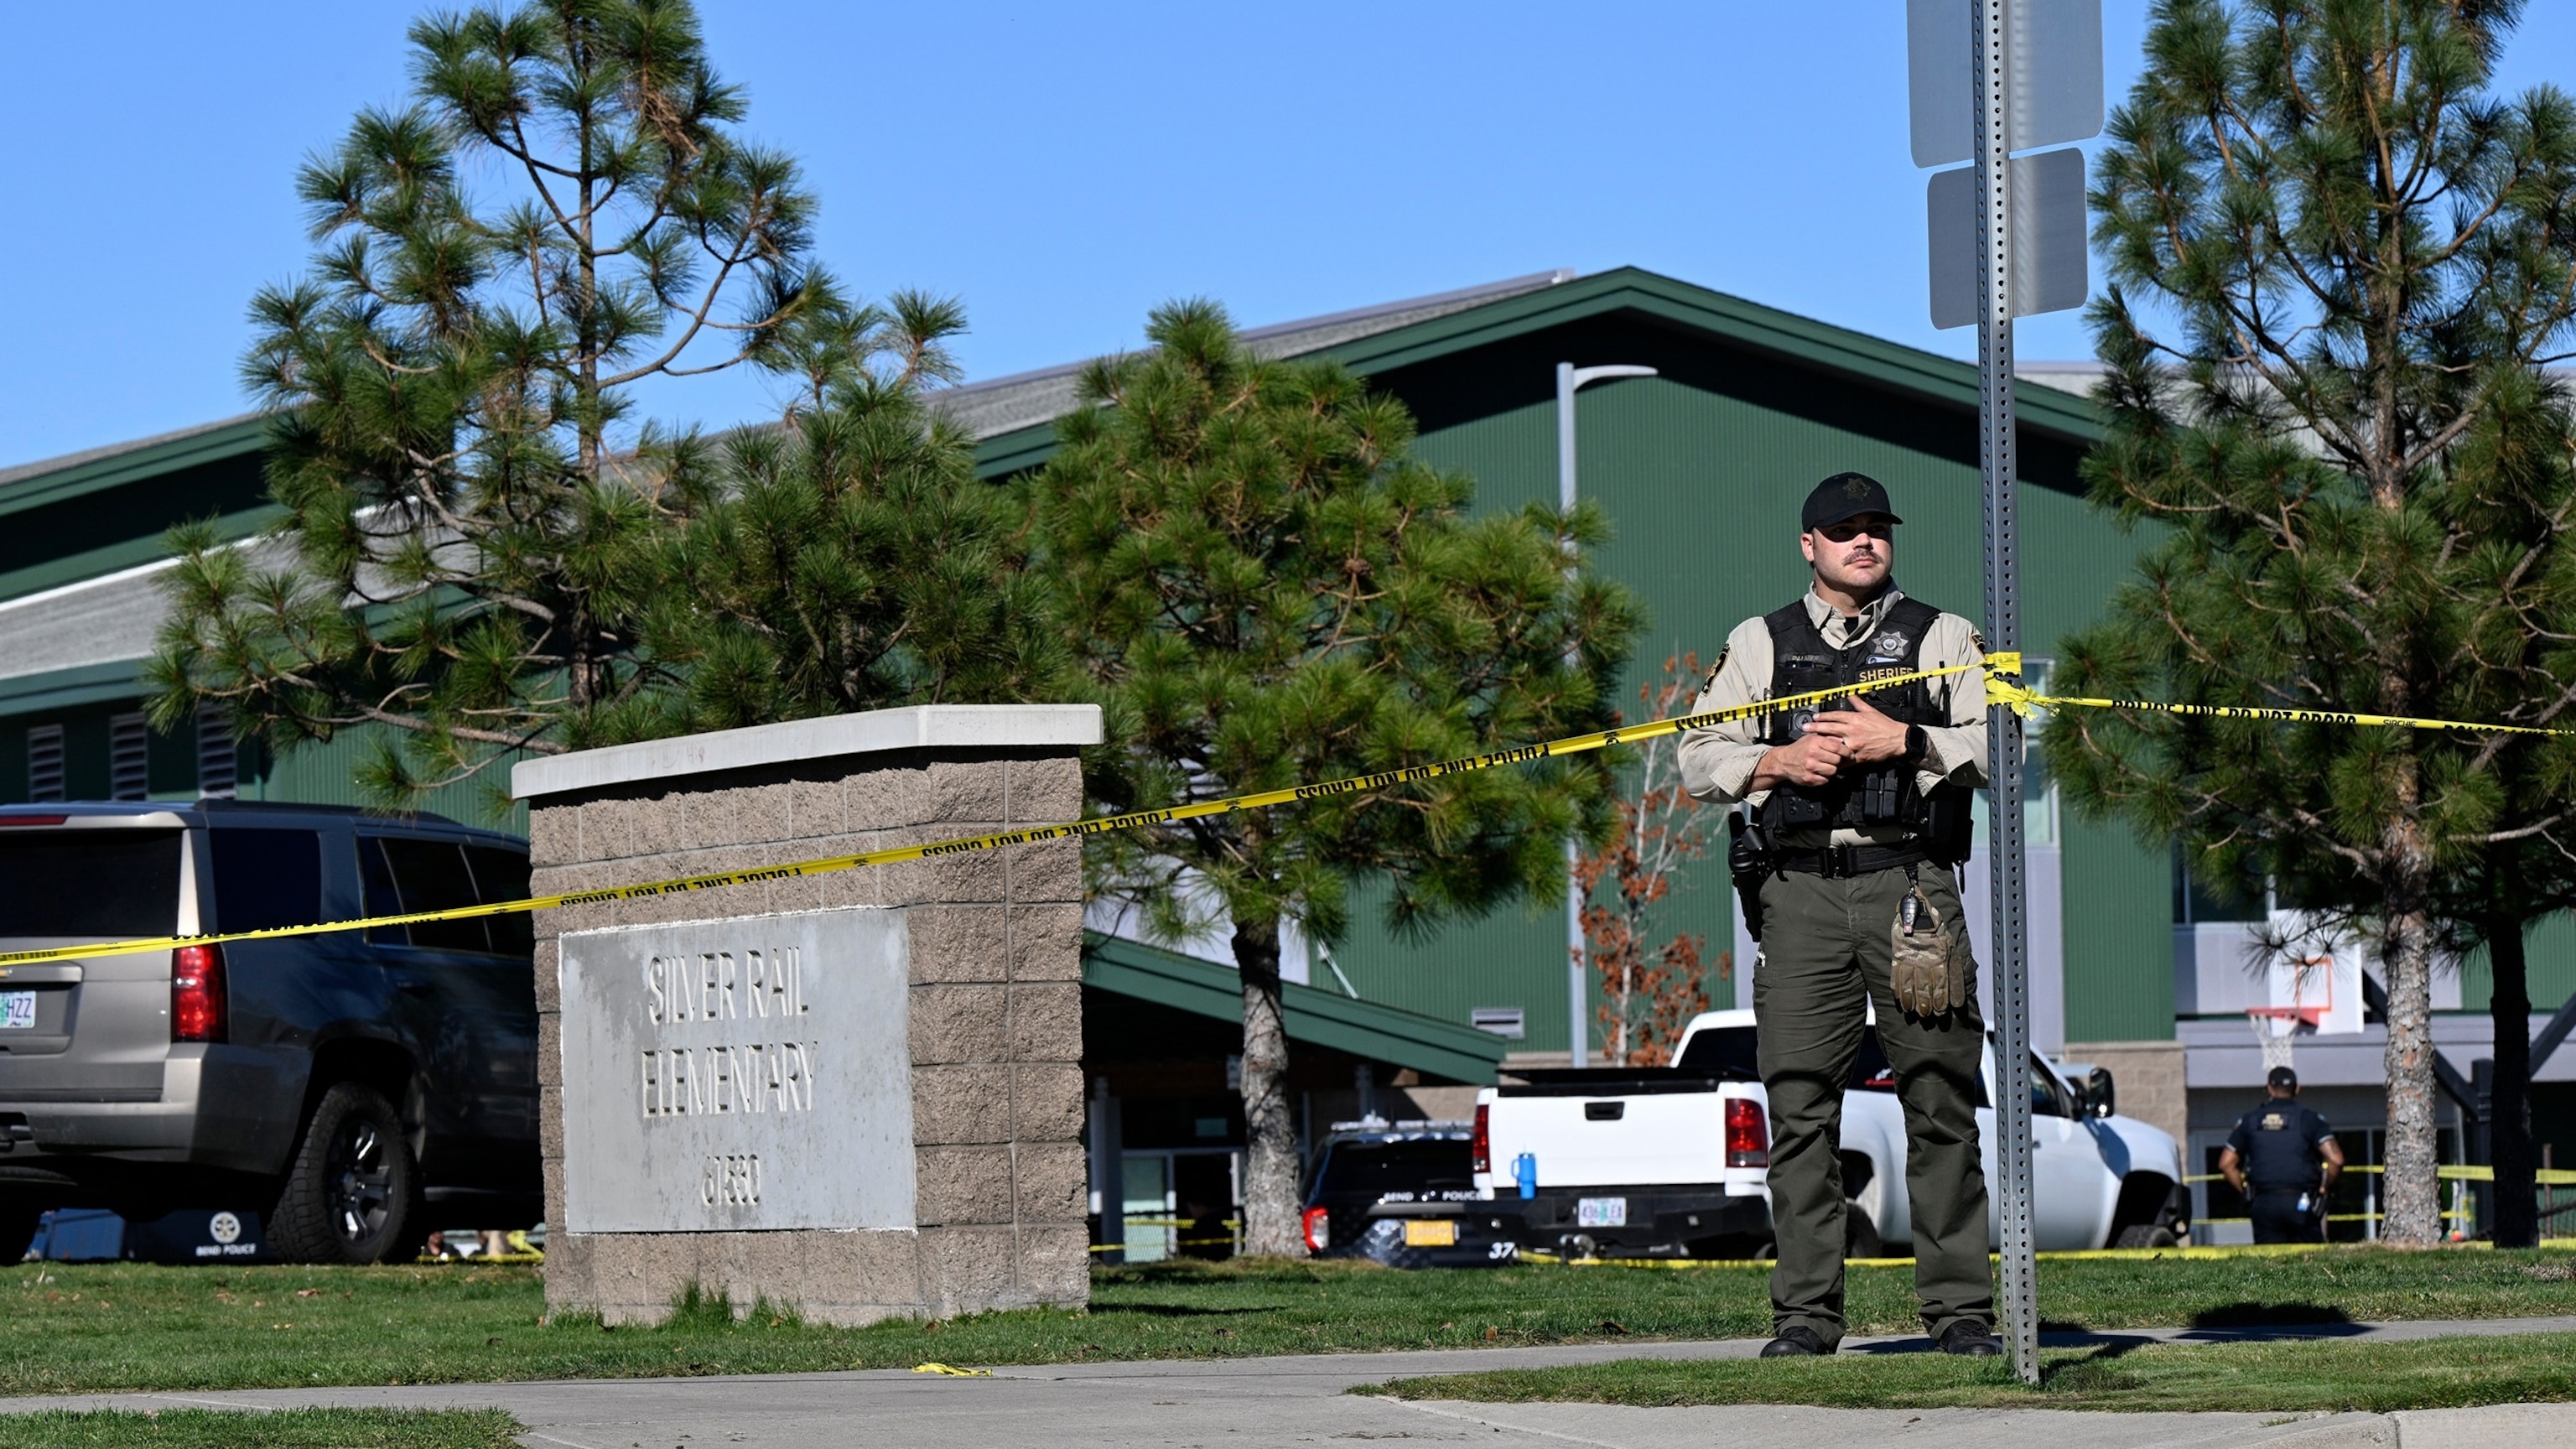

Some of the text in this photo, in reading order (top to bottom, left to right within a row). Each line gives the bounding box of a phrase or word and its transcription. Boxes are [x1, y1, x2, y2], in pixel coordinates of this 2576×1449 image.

[1482, 744, 1550, 767] POLICE
[1436, 756, 1478, 775] LINE
[1364, 771, 1400, 788] NOT
[1296, 780, 1356, 799] CROSS
[647, 946, 809, 1026] SILVER RAIL
[641, 1041, 818, 1119] ELEMENTARY
[701, 1154, 760, 1207] 61530
[1384, 1192, 1415, 1202] BEND
[195, 1243, 256, 1257] BEND POLICE
